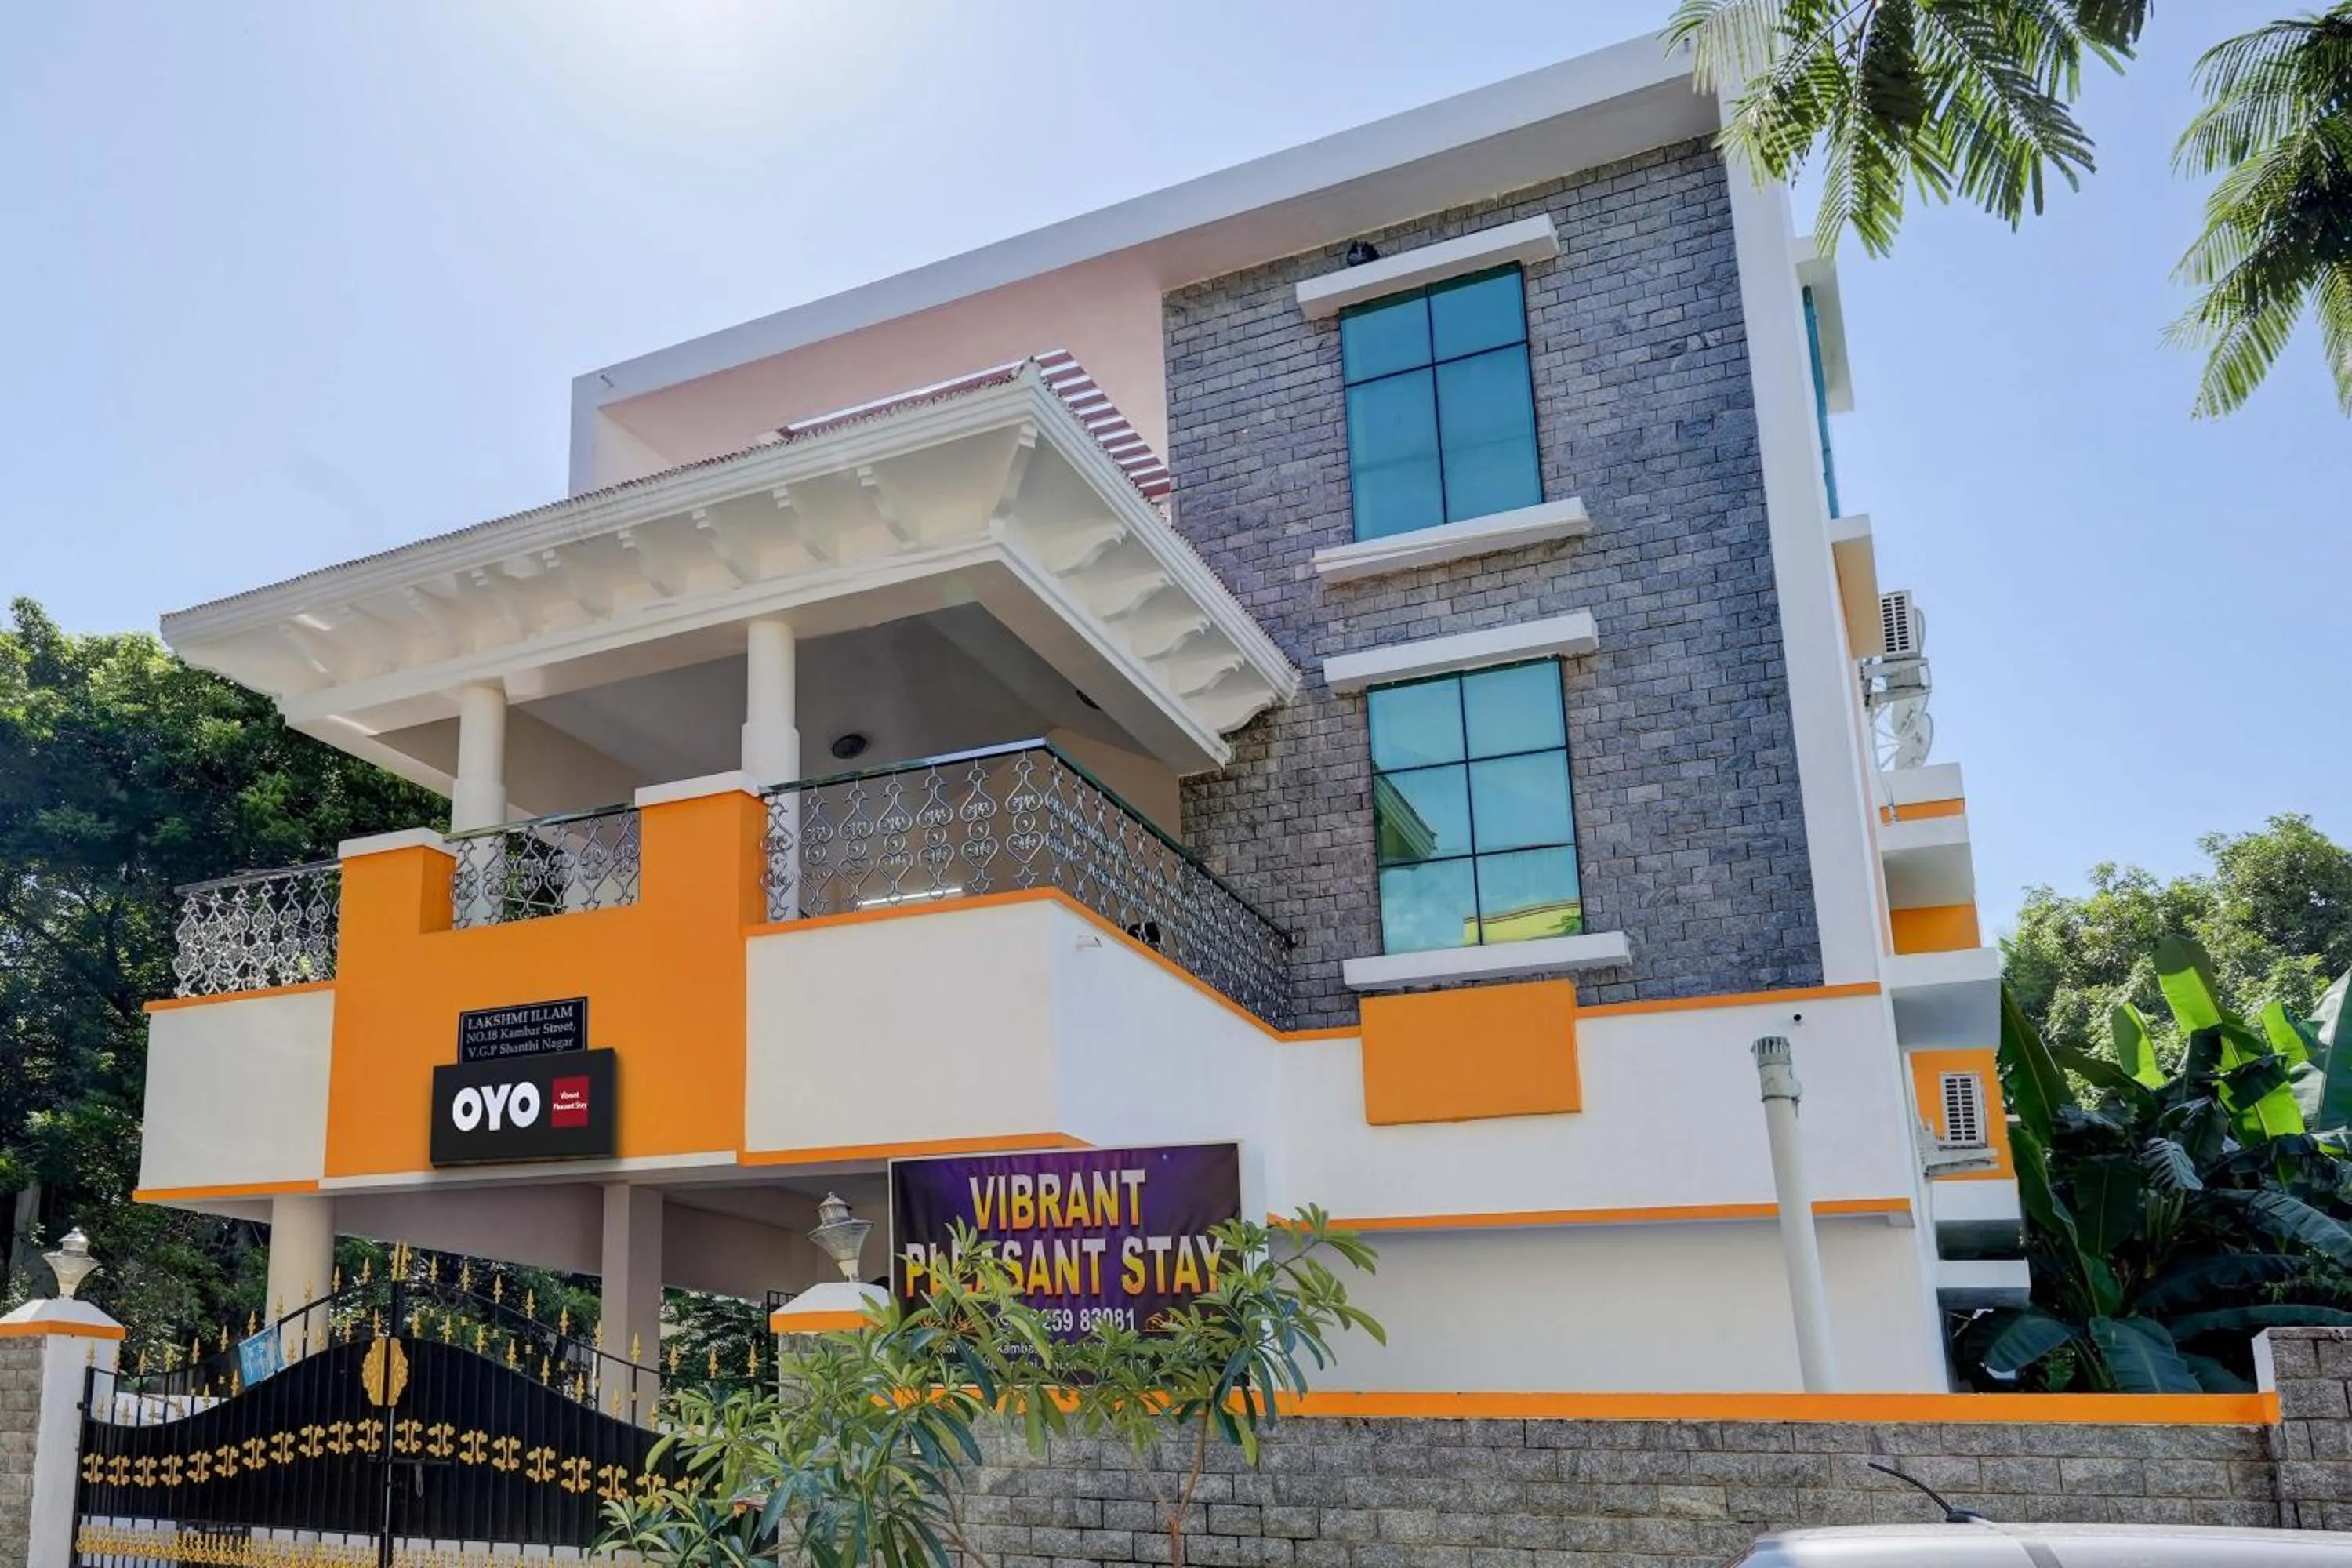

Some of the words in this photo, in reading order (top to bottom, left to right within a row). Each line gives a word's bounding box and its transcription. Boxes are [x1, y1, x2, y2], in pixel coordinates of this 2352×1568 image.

[466, 1029, 498, 1044] NO.18
[500, 1025, 541, 1039] Kambar
[468, 1011, 528, 1029] LAKSHMI
[531, 1005, 573, 1022] ILLAM
[499, 1039, 539, 1054] Shanthi
[542, 1037, 574, 1051] Nagar
[452, 1081, 541, 1131] OYO
[969, 1168, 1145, 1231] VIBRANT
[1121, 1235, 1224, 1295] STAY
